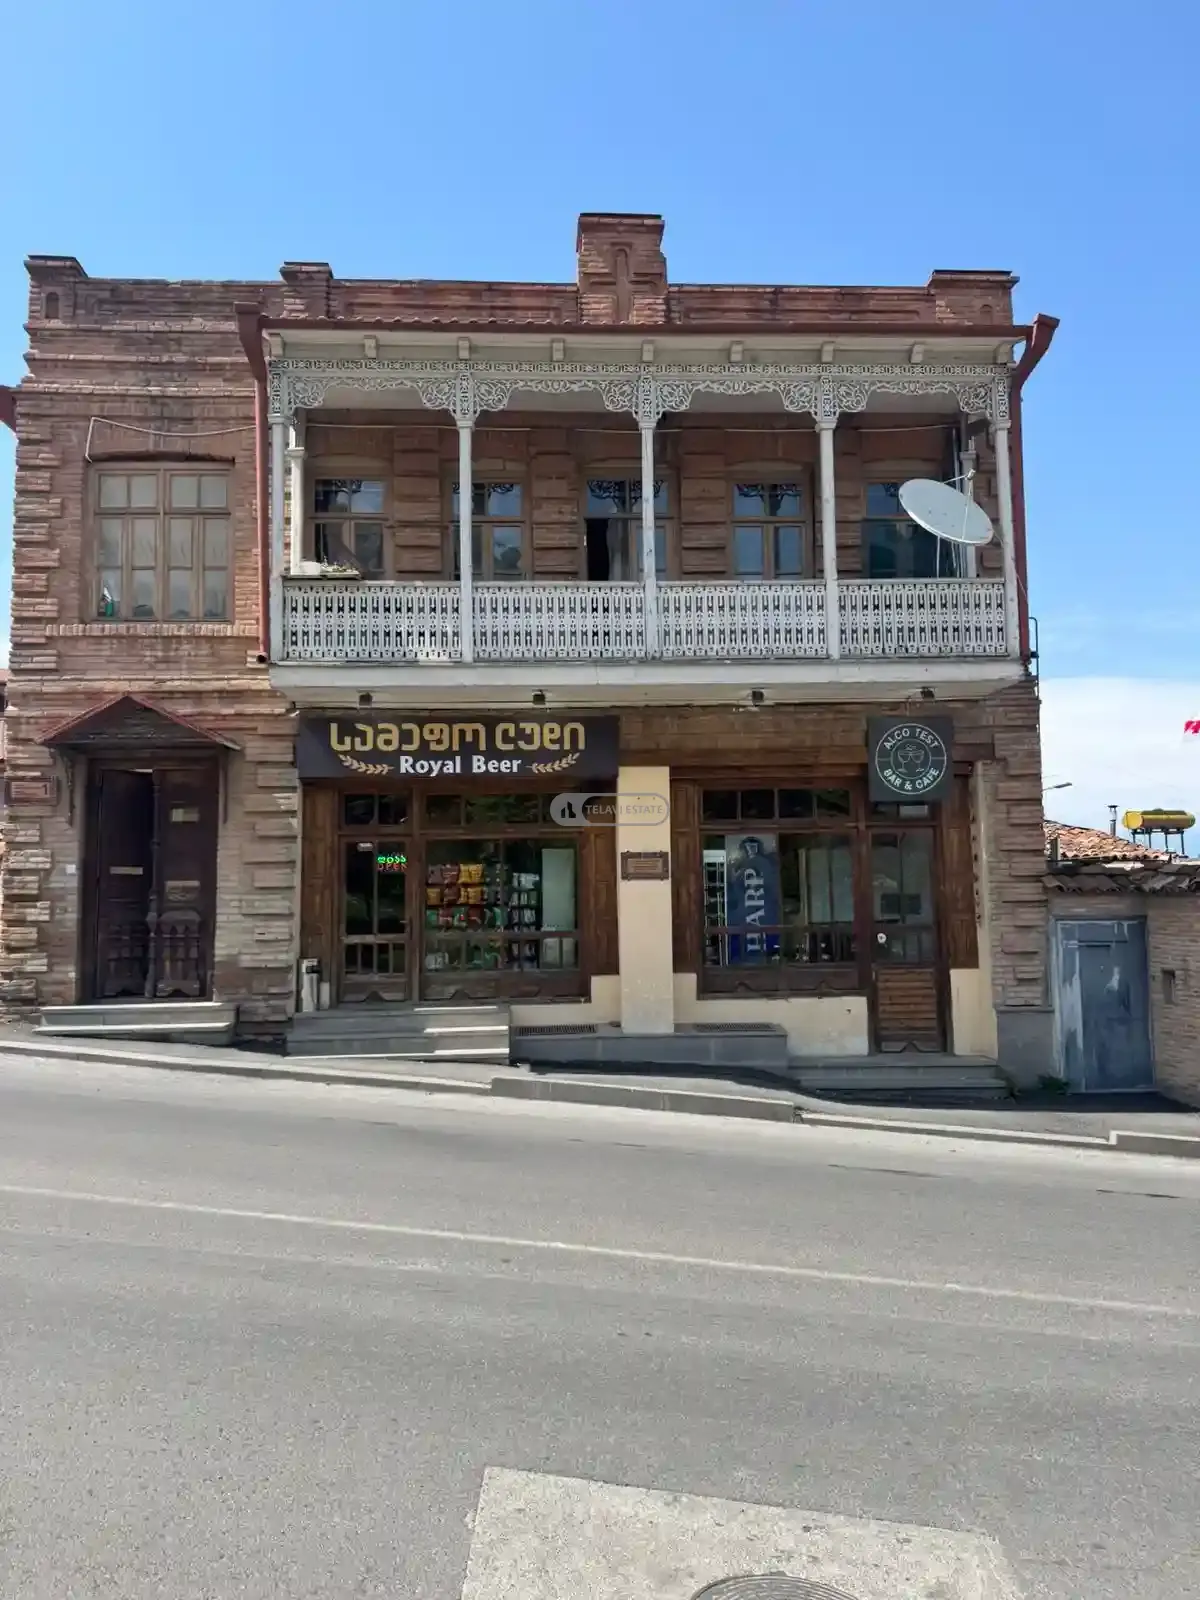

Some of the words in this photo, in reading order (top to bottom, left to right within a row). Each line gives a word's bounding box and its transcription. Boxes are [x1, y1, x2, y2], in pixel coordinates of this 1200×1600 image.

[329, 722, 487, 751] სამეფო
[494, 722, 586, 751] ლუდი
[883, 728, 910, 750] ALCO
[915, 728, 940, 748] TEST
[399, 755, 462, 777] Royal
[472, 755, 522, 774] Beer
[883, 768, 902, 787] BAR
[904, 780, 913, 791] &
[915, 767, 940, 789] CAFE
